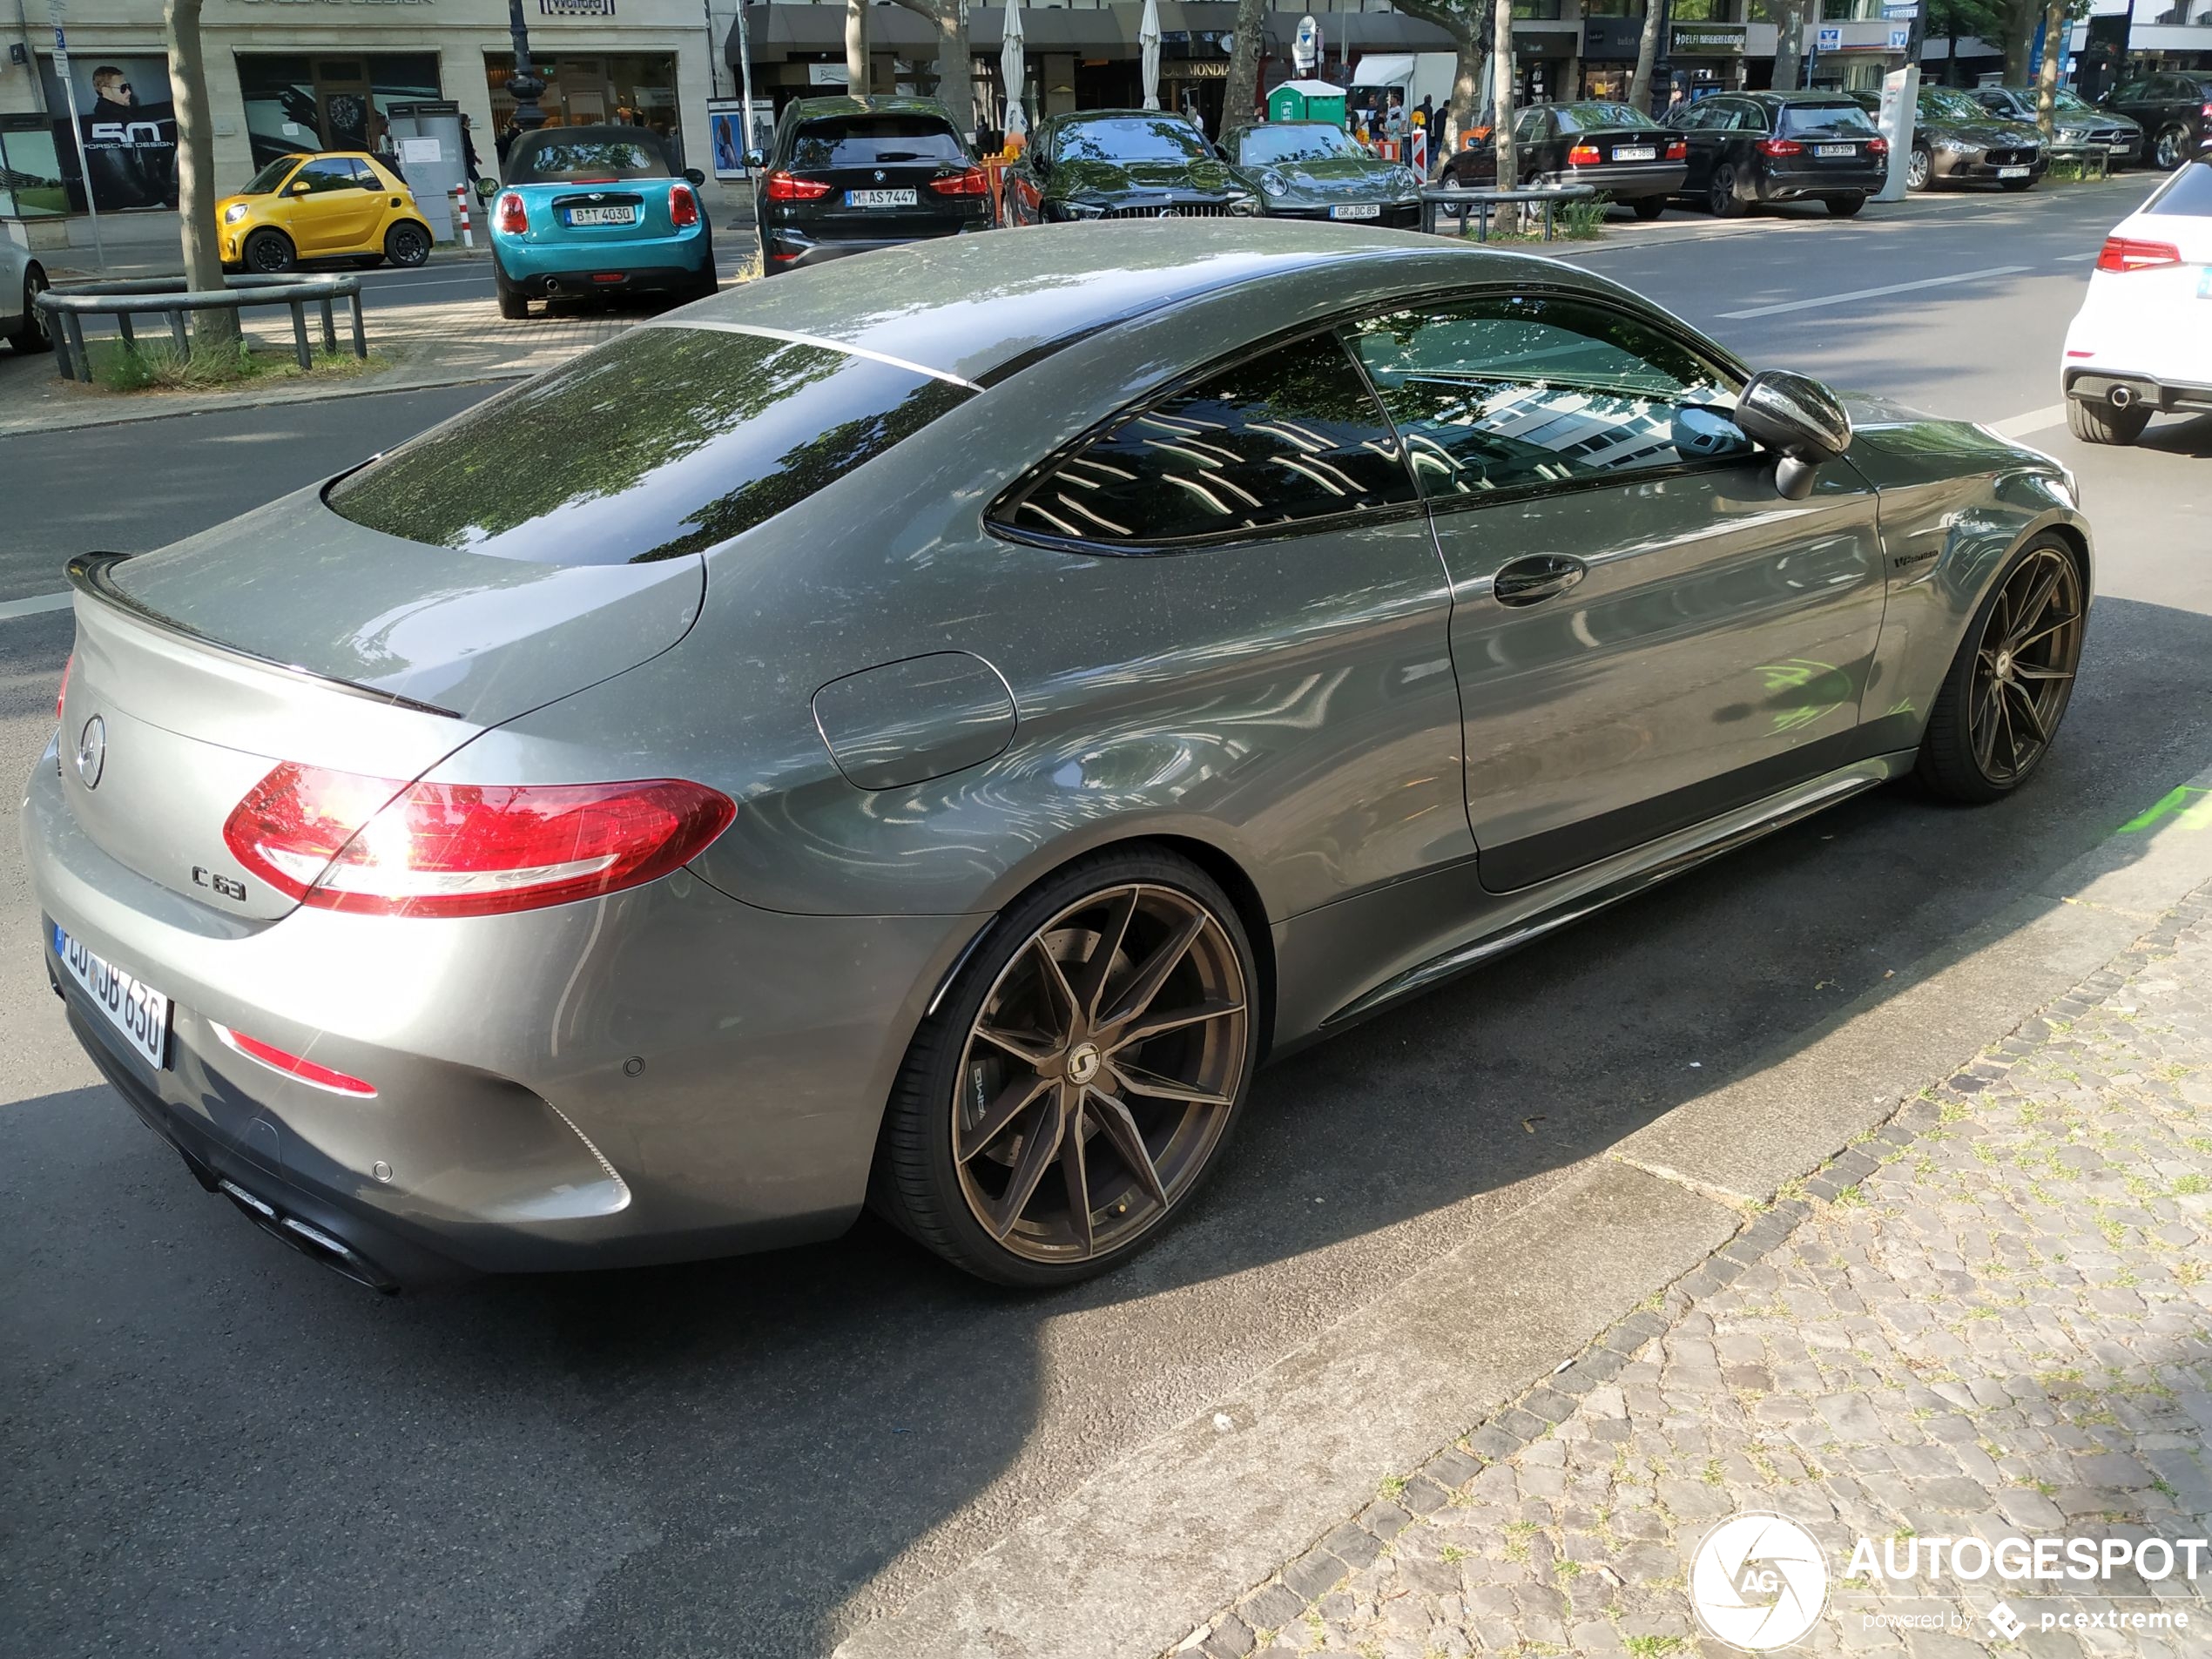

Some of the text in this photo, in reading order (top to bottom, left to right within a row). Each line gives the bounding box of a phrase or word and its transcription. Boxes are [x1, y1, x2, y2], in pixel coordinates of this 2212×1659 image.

[1680, 35, 1698, 44] DELFI
[853, 191, 915, 204] M AS 7447
[576, 207, 631, 222] B T 4030
[1338, 206, 1377, 216] GR DC 85
[192, 865, 246, 902] C 63
[98, 963, 119, 1013] JB
[125, 975, 159, 1055] 630
[974, 1068, 986, 1116] AMG
